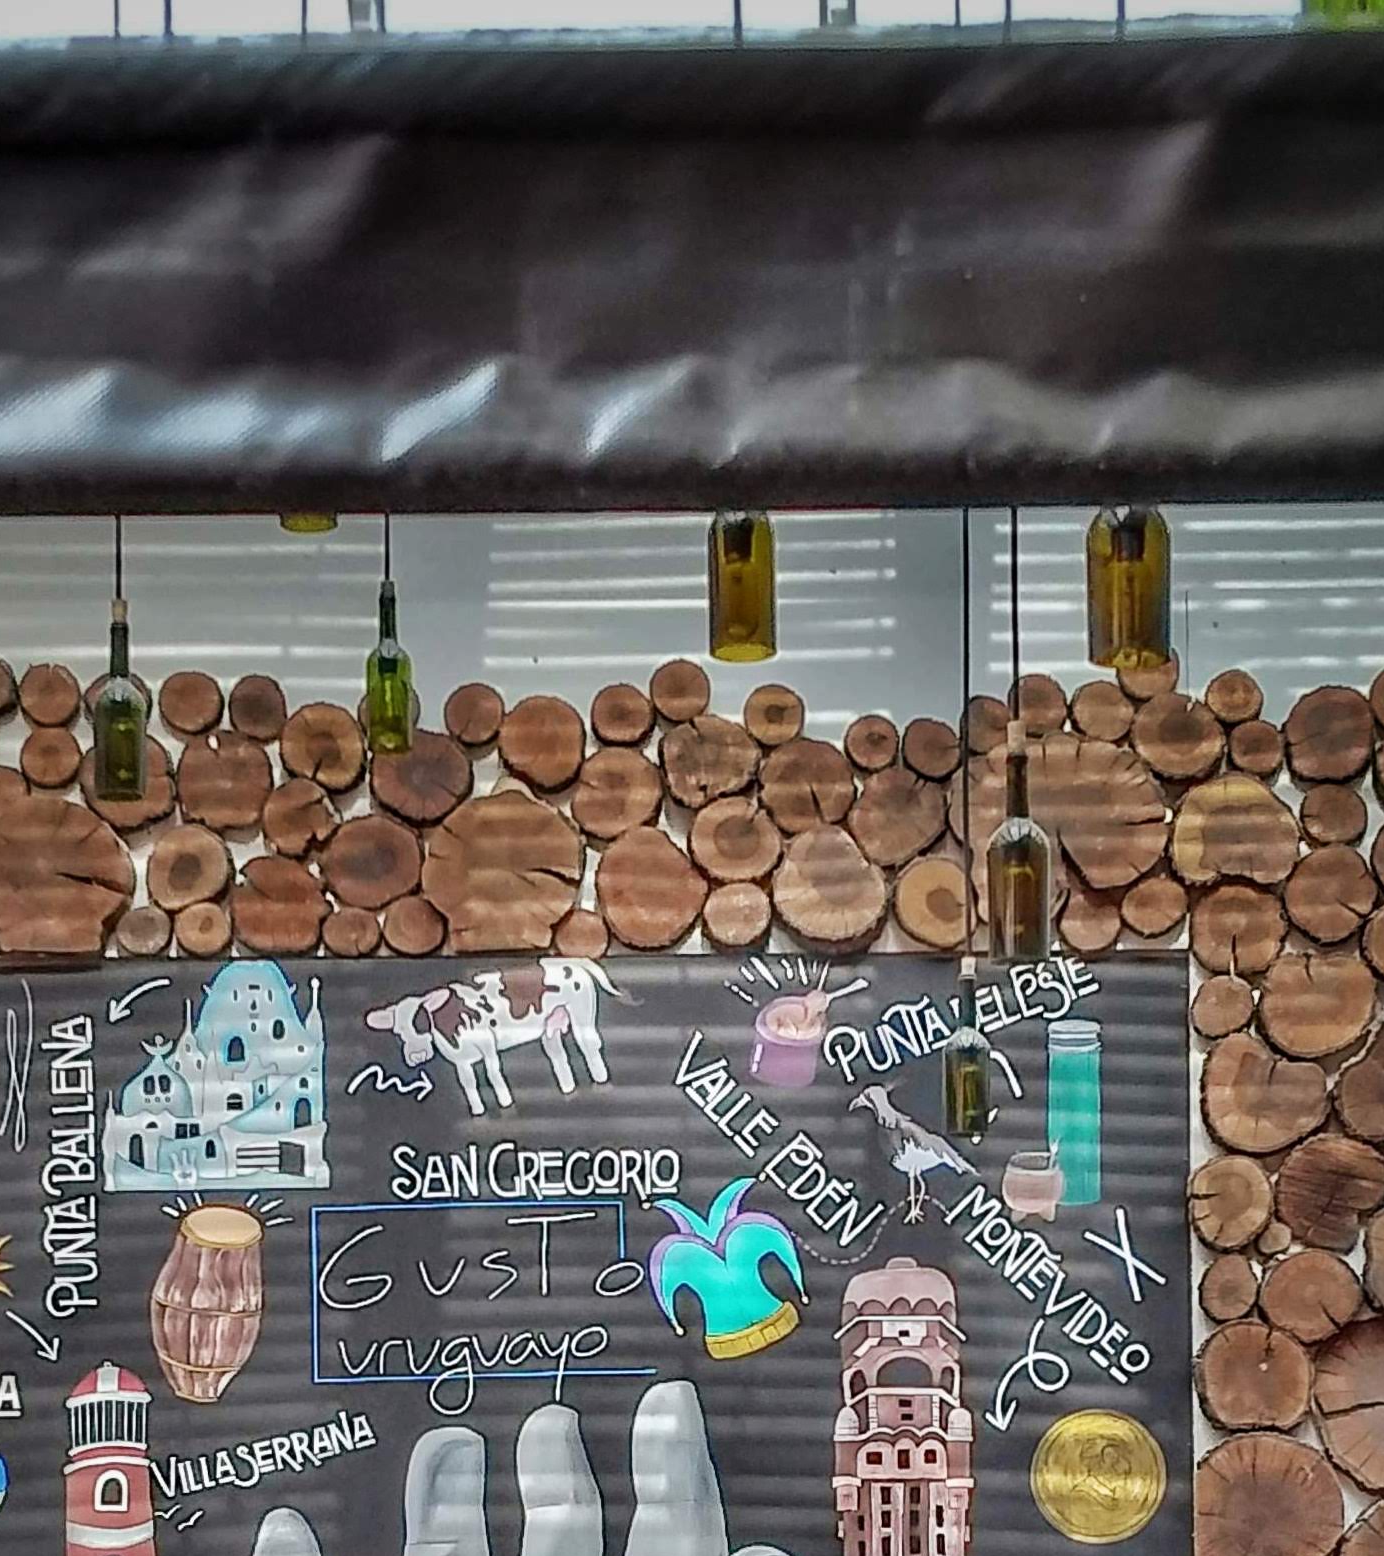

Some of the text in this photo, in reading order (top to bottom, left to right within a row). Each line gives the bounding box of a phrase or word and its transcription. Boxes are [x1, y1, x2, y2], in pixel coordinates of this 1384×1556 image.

[675, 1030, 779, 1158] VALLE
[823, 994, 949, 1083] PUNTA
[41, 1015, 99, 1318] PUNTA BALLENA
[391, 1142, 680, 1201] SAN GREGORIO
[944, 1184, 1151, 1384] MONTEVIDEO
